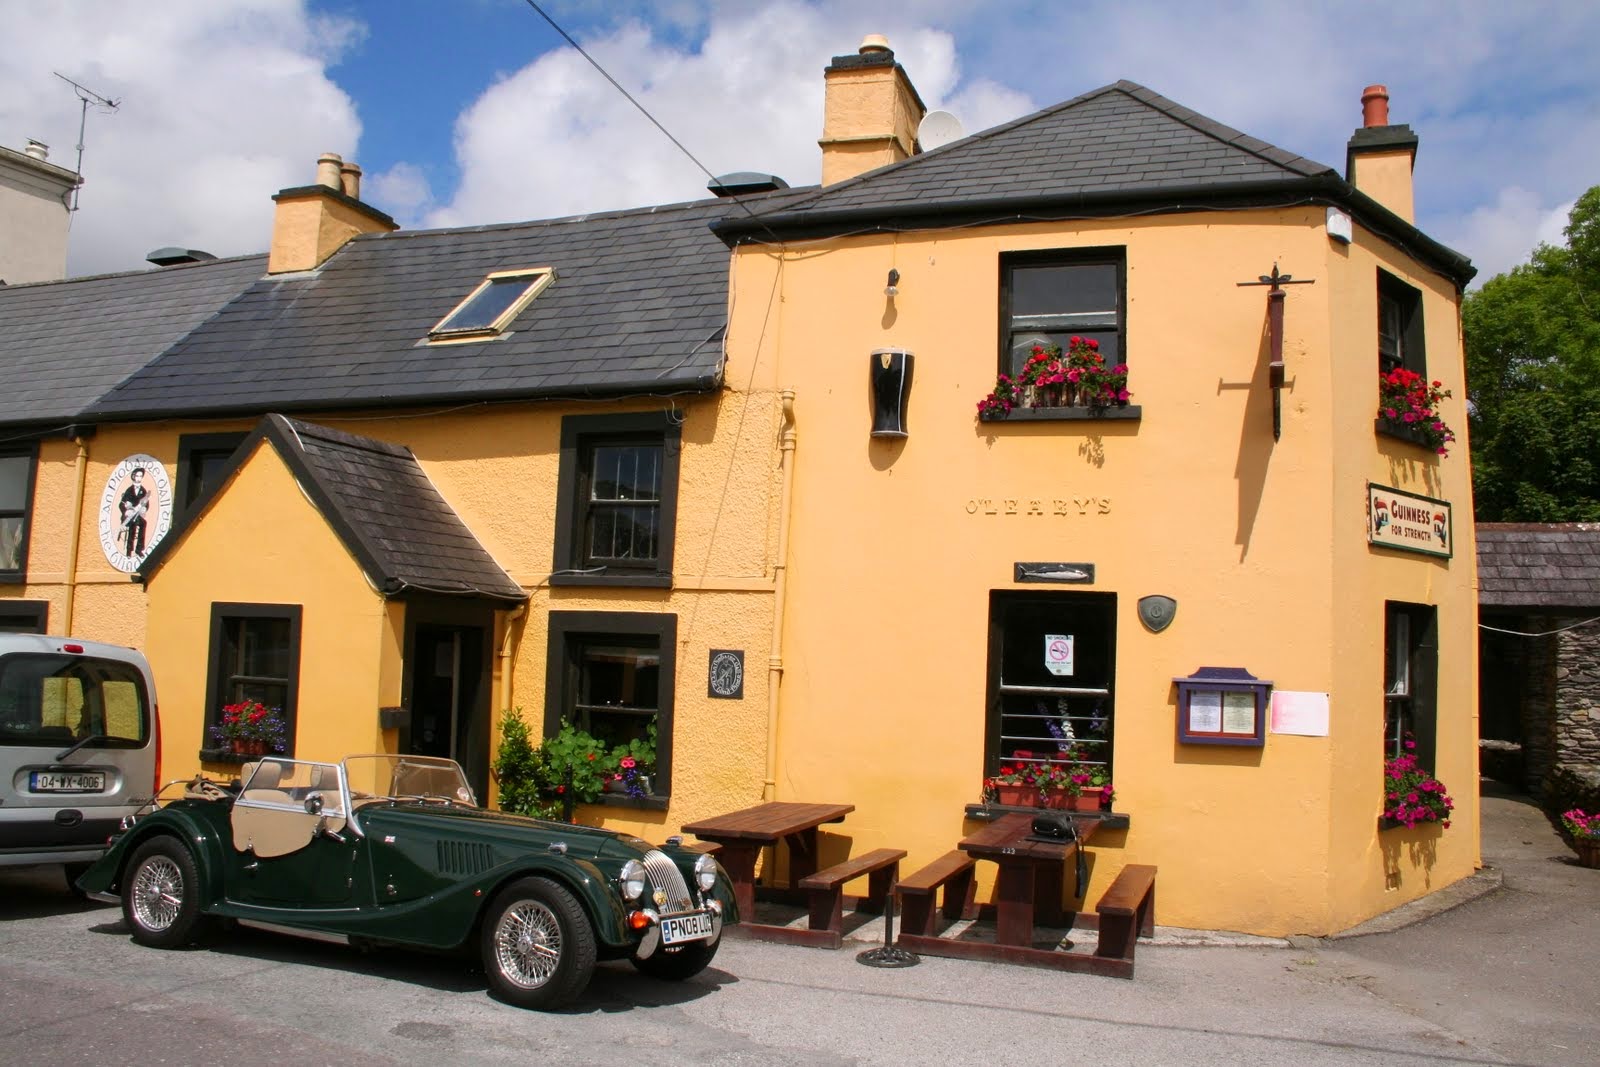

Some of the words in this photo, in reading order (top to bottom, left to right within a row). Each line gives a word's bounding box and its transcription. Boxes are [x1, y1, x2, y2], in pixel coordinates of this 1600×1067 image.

[1391, 500, 1430, 525] GUINNESS
[1391, 525, 1402, 536] FOR
[1404, 527, 1431, 541] STRENGTH
[670, 917, 698, 938] PN08
